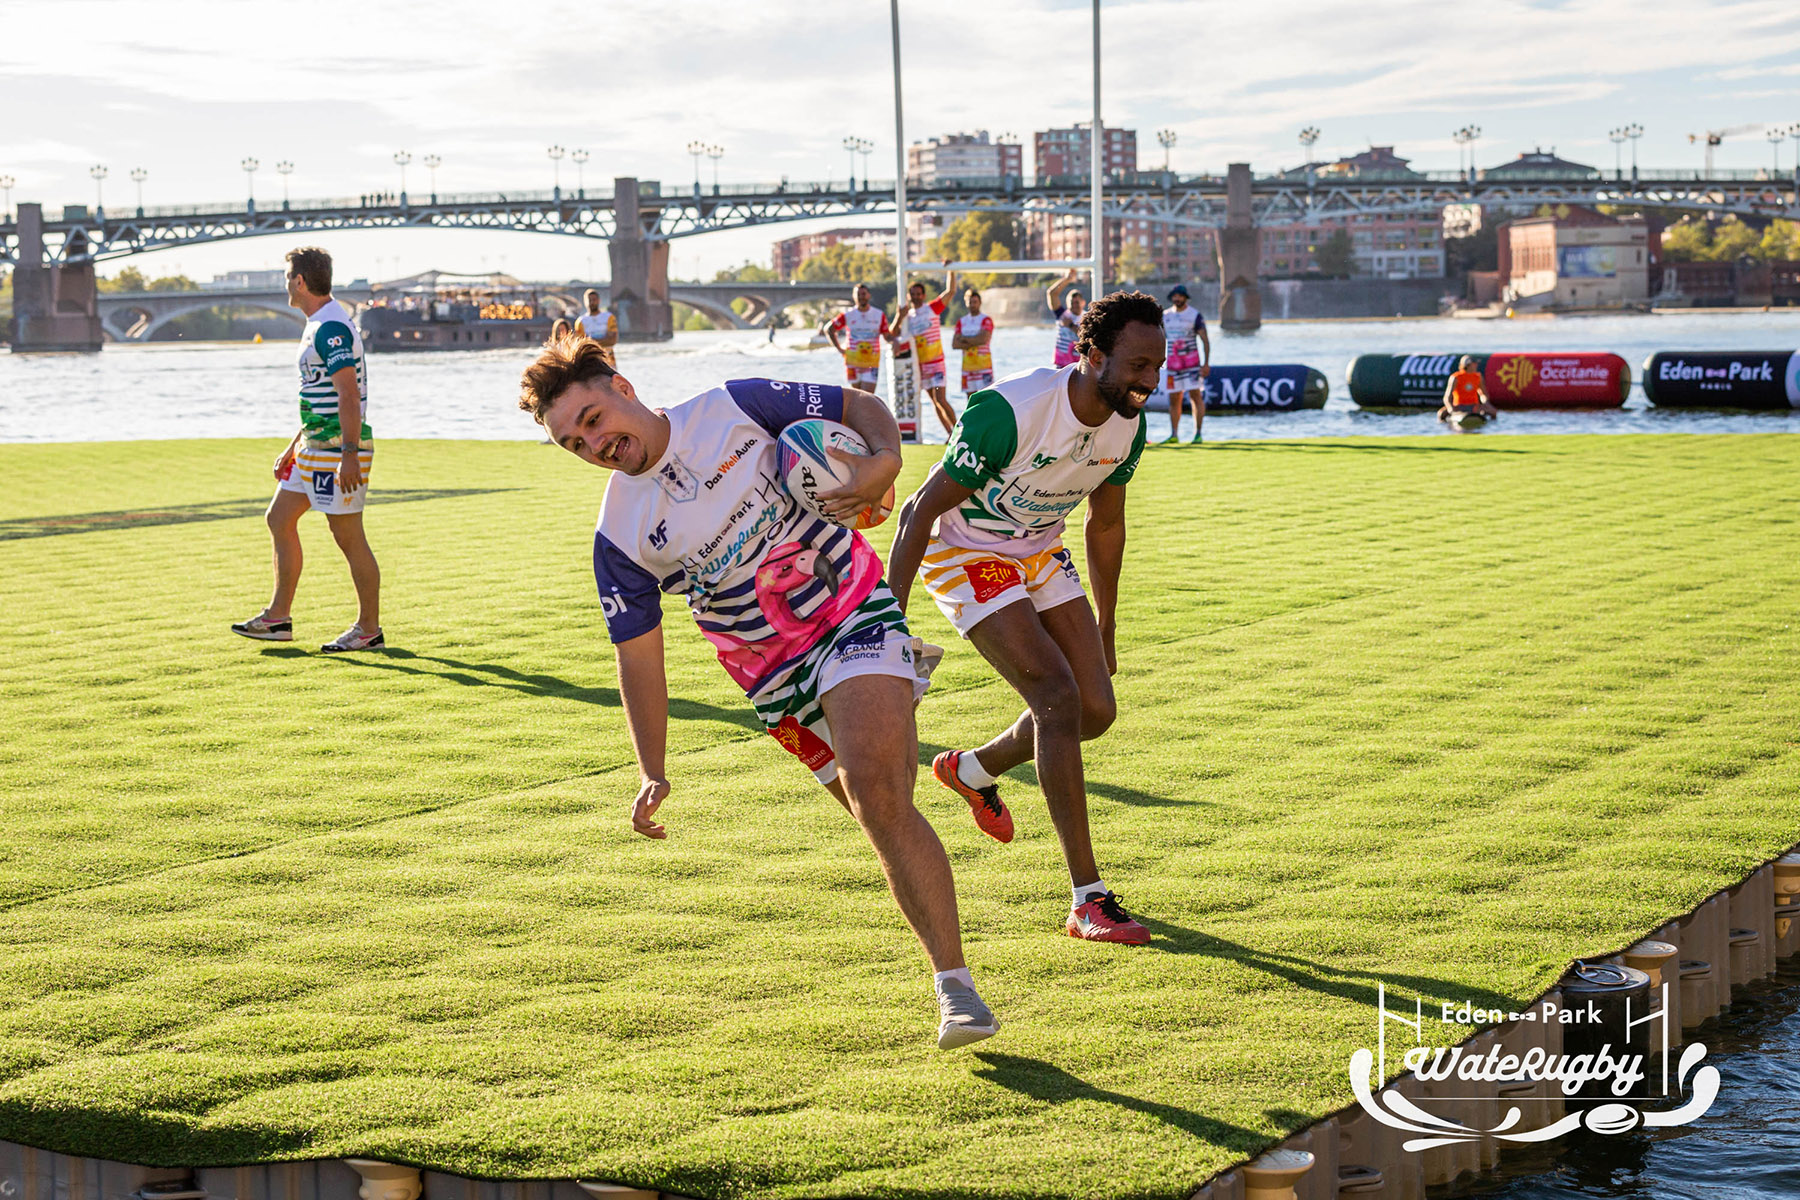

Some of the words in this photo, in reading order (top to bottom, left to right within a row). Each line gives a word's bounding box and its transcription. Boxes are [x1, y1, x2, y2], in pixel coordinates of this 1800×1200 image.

[327, 336, 343, 348] 90
[1540, 365, 1609, 379] Occitanie
[1660, 360, 1703, 380] Eden
[1728, 360, 1773, 380] Park
[1220, 378, 1295, 406] MSC
[1087, 459, 1099, 467] Das
[704, 473, 723, 490] Das
[1033, 489, 1056, 499] Eden
[697, 535, 724, 560] Eden
[729, 500, 755, 524] Park
[840, 652, 880, 664] vacances
